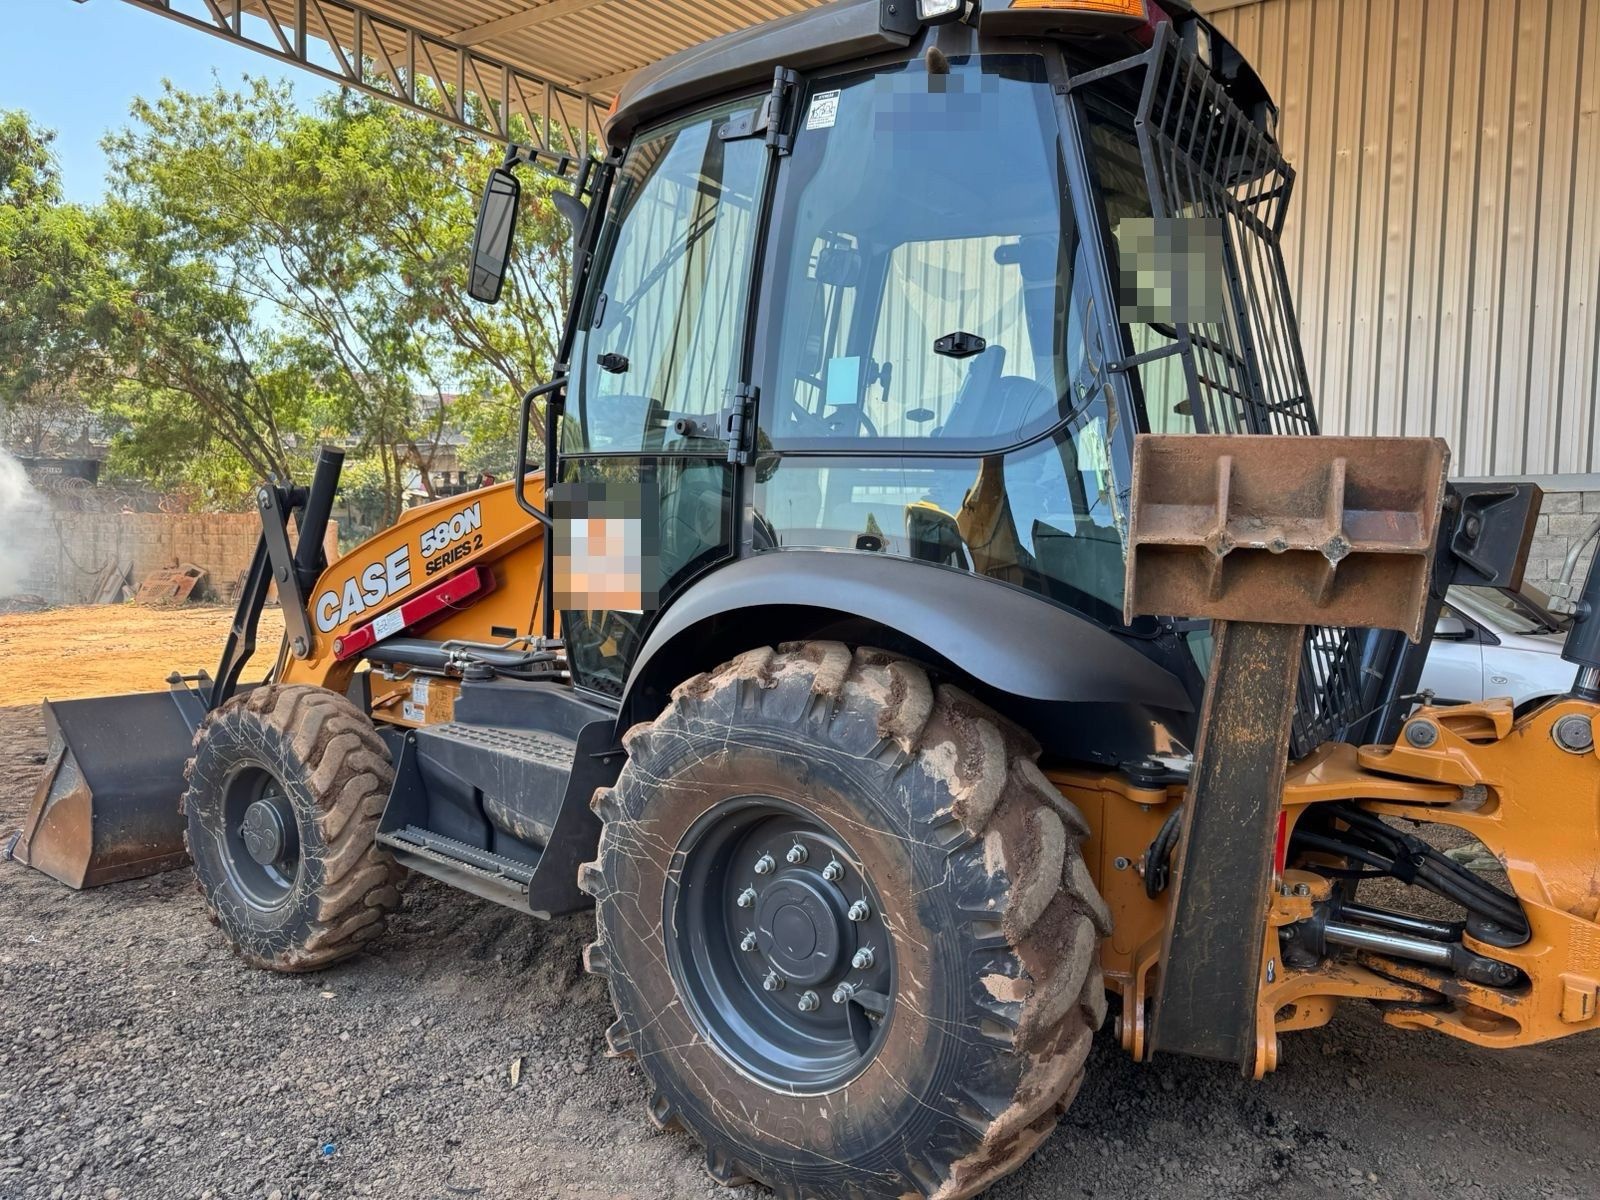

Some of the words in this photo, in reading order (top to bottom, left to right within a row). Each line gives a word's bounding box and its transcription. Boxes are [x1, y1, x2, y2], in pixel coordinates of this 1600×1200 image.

[420, 501, 482, 558] 580N
[426, 542, 472, 576] SERIES
[473, 534, 483, 551] 2
[316, 544, 411, 633] CASE
